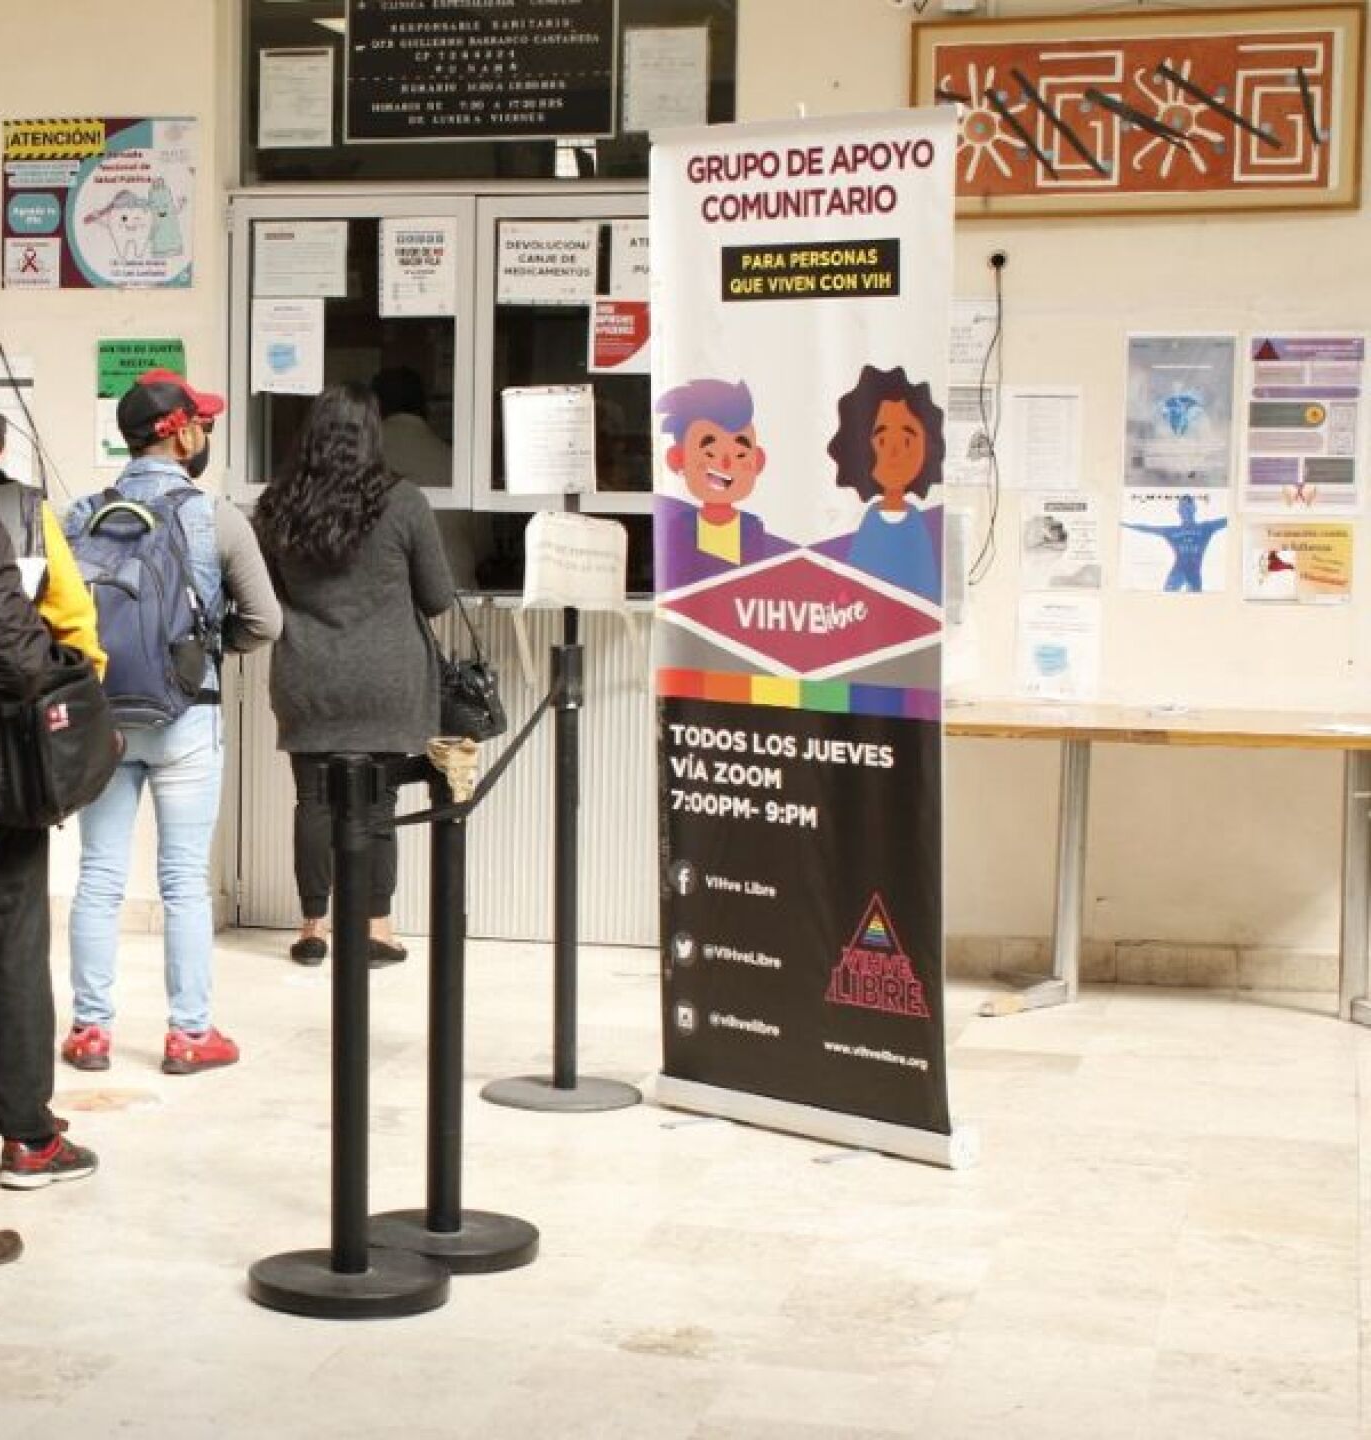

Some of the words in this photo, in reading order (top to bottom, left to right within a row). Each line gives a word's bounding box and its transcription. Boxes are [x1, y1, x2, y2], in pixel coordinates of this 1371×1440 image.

[4, 128, 101, 149] ¡ATENCIÓN!
[687, 151, 781, 184] GRUPO
[787, 147, 825, 177] DE
[830, 139, 935, 174] APOYO
[701, 184, 898, 223] COMUNITARIO
[503, 266, 590, 277] MEDICAMENTOS
[518, 253, 558, 264] CANJE
[561, 254, 577, 264] DE
[742, 253, 787, 270] PARA
[790, 248, 879, 269] PERSONAS
[730, 276, 764, 294] QUE
[767, 275, 814, 293] VIVEN
[819, 273, 858, 291] CON
[861, 272, 893, 289] VIH
[735, 598, 829, 634] VIHVE
[669, 723, 748, 753] TODOS
[752, 732, 798, 758] LOS
[802, 738, 895, 769] JUEVES
[670, 753, 709, 783] VÍA
[713, 762, 783, 790] ZOOM
[670, 790, 760, 820] 7:00PM-
[765, 801, 819, 829] 9:PM
[705, 873, 742, 893] VIHve
[744, 880, 778, 898] Libre
[824, 966, 931, 1018] LIBRE
[824, 1040, 929, 1072] www.vihvelibre.org
